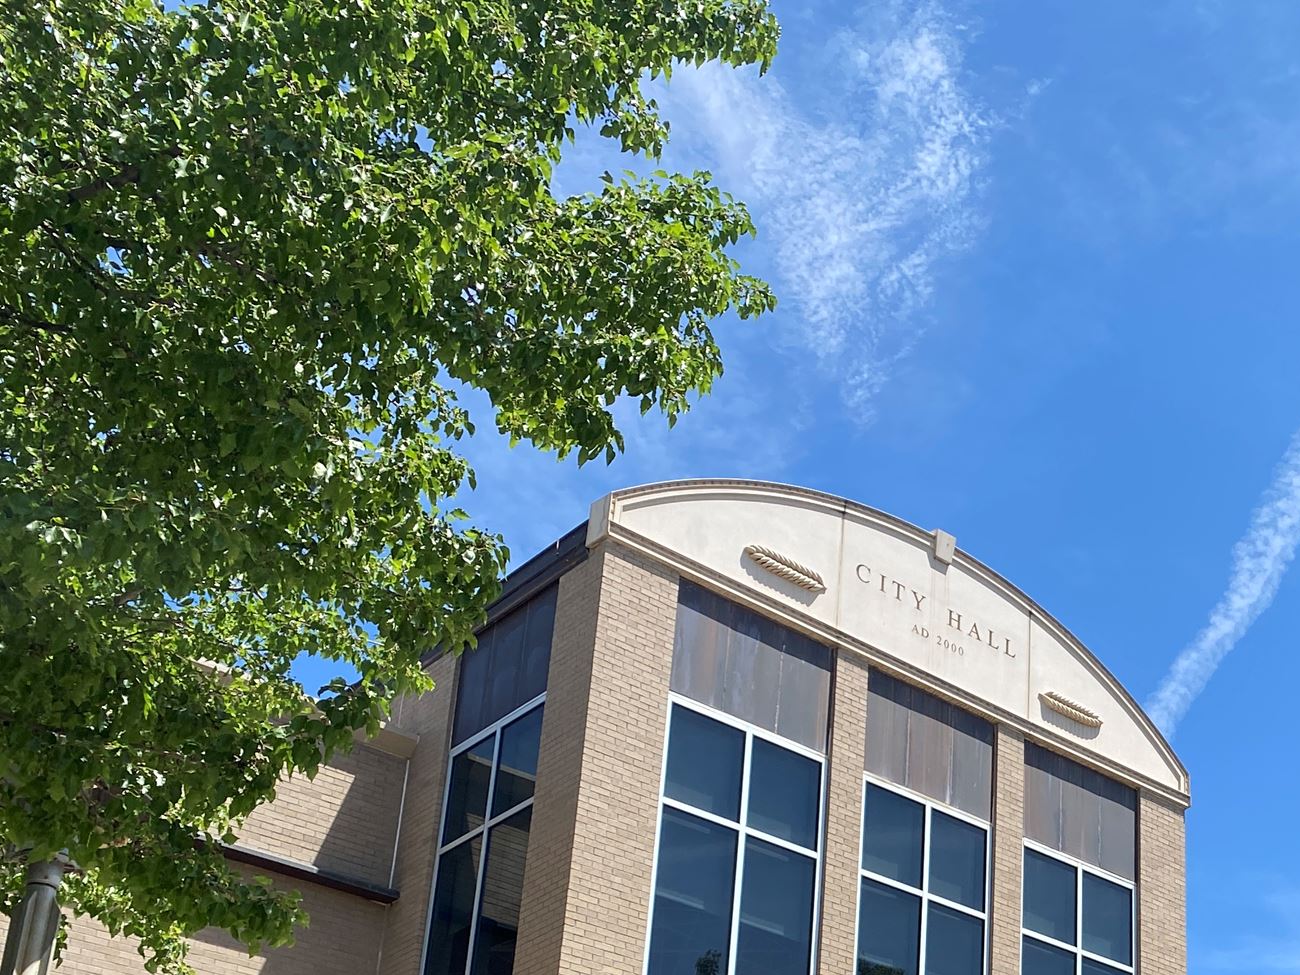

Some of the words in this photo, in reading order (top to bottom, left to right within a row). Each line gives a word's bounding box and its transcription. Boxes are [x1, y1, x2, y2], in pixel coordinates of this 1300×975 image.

[856, 564, 926, 611] CITY
[947, 608, 1017, 658] HALL
[911, 624, 930, 639] AD
[936, 635, 965, 656] 2000
